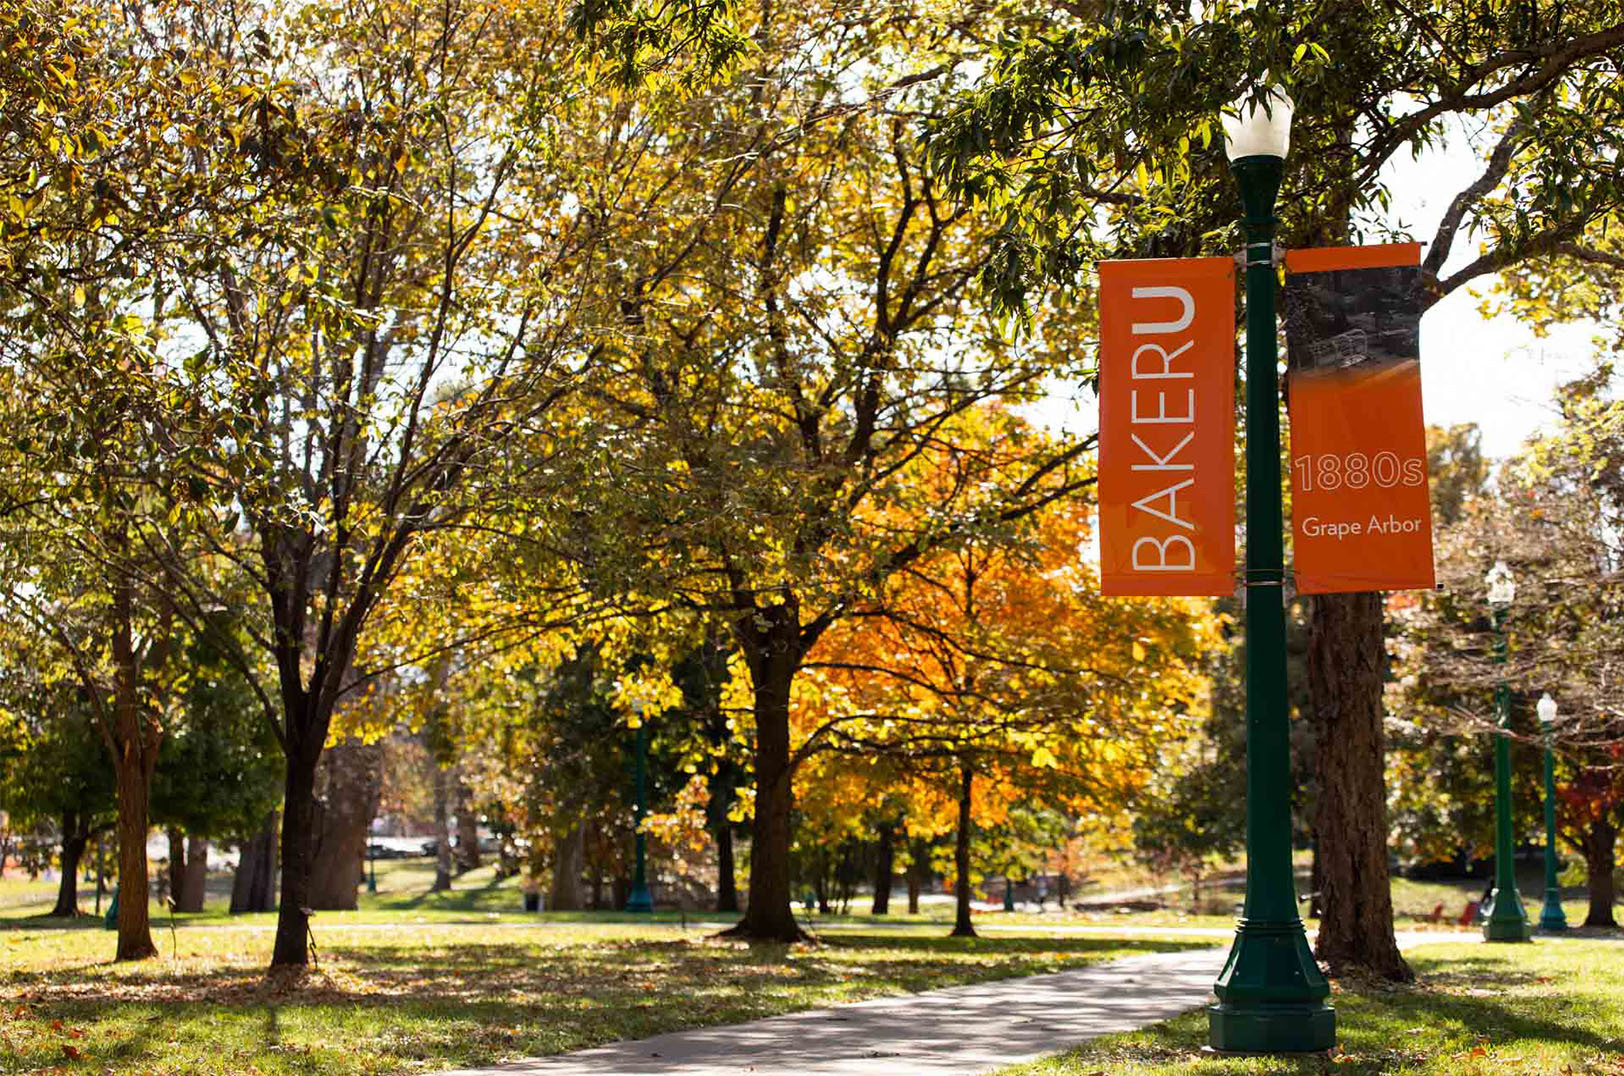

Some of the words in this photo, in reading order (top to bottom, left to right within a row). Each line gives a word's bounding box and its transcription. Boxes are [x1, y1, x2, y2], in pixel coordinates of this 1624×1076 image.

[1131, 285, 1196, 572] BAKERU
[1294, 451, 1424, 492] 1880s
[1302, 517, 1361, 541] Grape
[1367, 514, 1422, 535] Arbor
